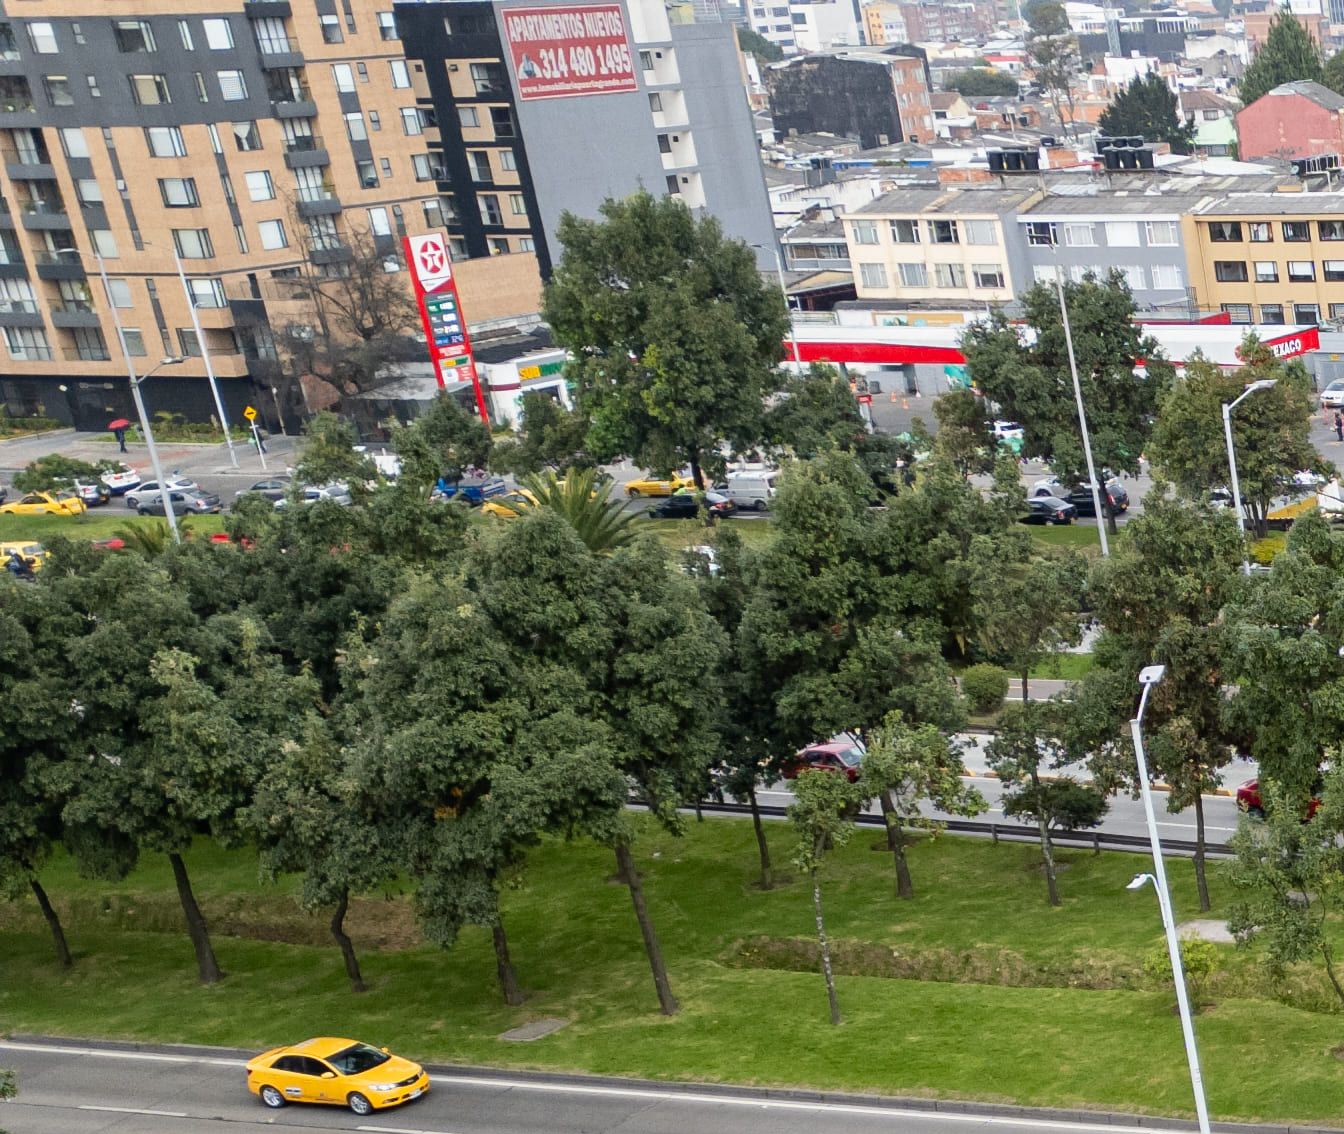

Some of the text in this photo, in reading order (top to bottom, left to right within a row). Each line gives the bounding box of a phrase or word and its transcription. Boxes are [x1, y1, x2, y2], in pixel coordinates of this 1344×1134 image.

[507, 10, 624, 42] APARTAMENTOS NUEVOS
[540, 43, 632, 80] 314 480 1495
